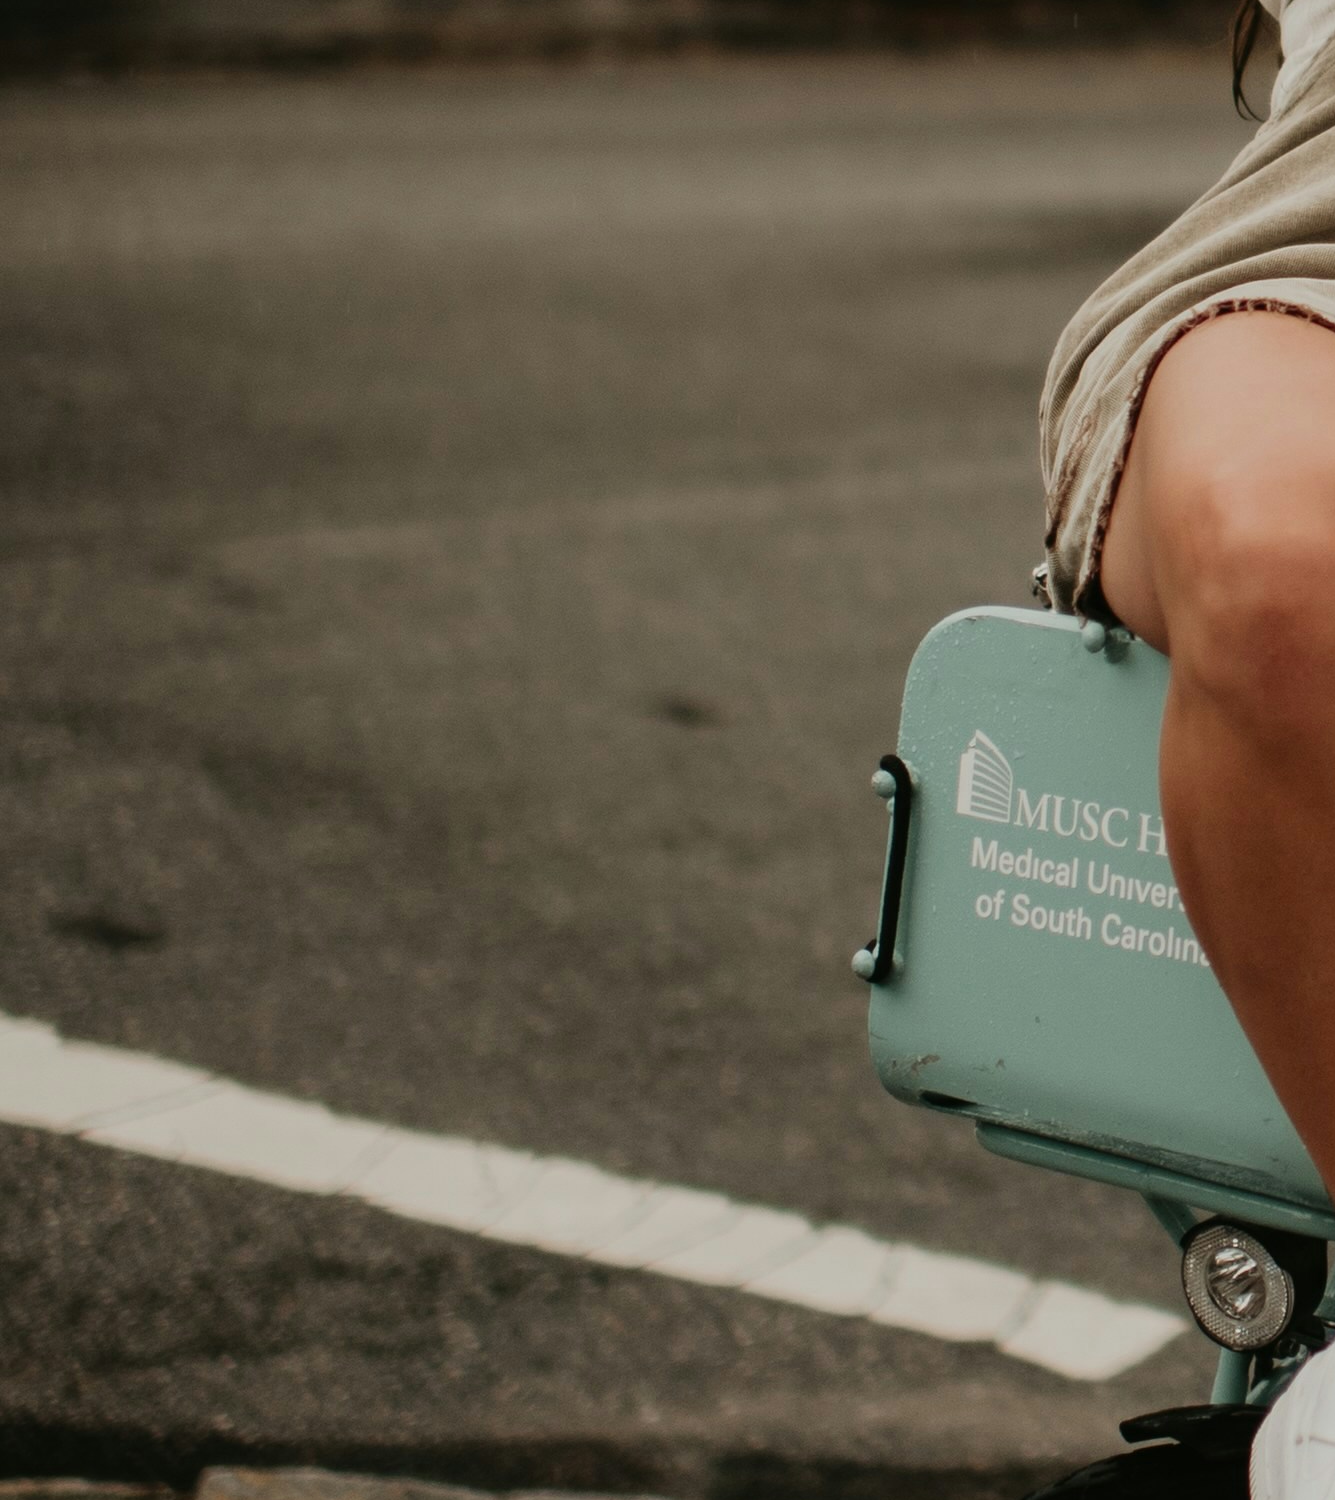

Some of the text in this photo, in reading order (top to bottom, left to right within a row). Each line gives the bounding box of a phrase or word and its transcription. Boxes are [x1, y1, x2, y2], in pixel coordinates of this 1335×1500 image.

[1014, 788, 1129, 848] MUSC
[971, 837, 1078, 889] Medical
[975, 889, 1006, 920] of
[1011, 894, 1093, 941] South
